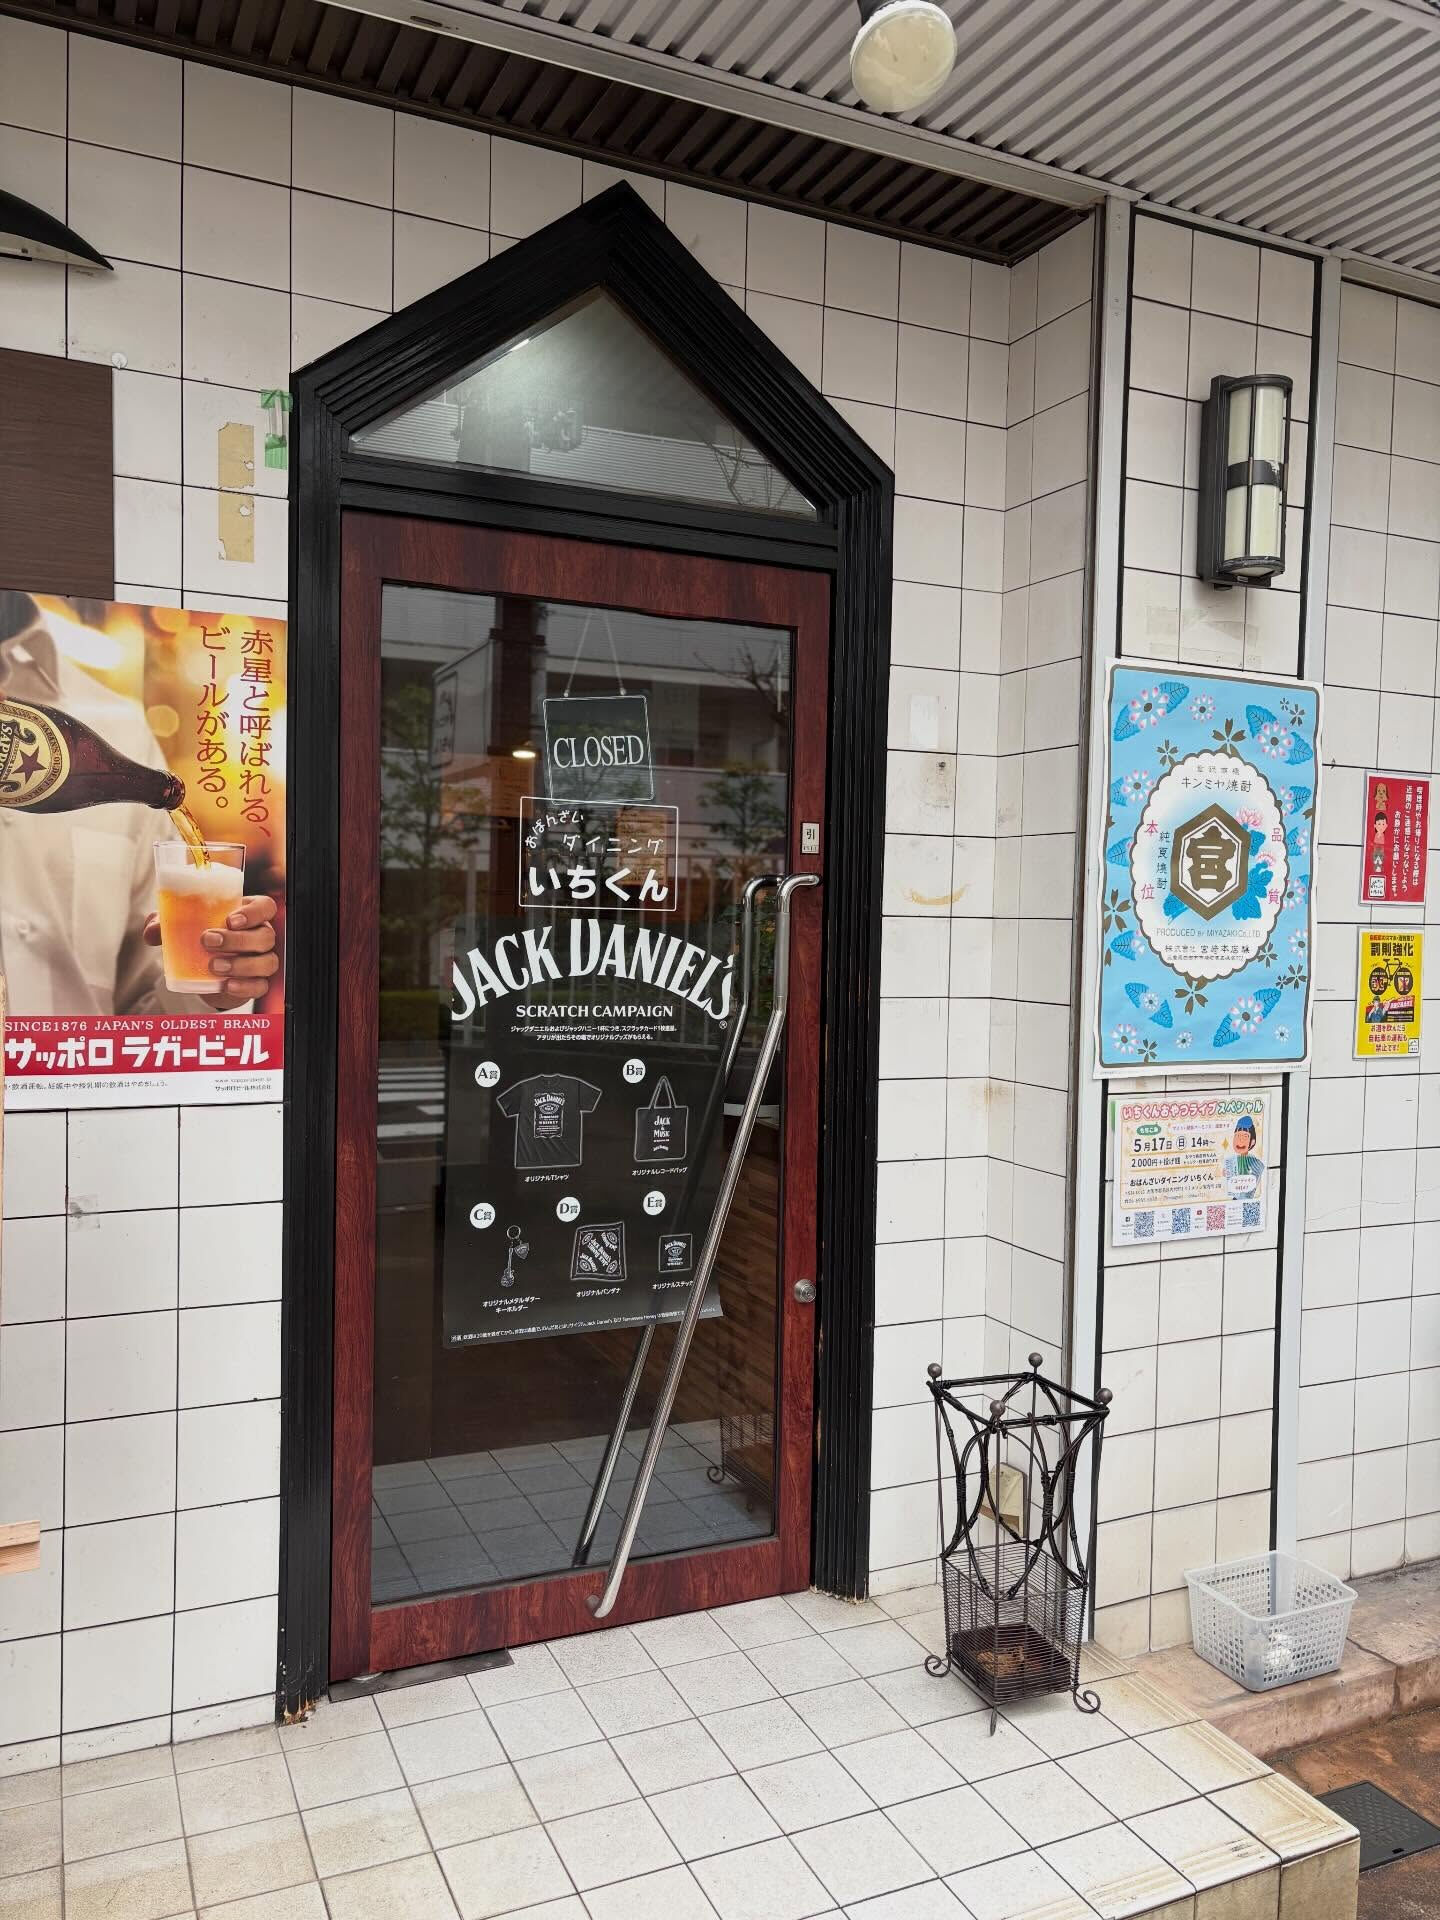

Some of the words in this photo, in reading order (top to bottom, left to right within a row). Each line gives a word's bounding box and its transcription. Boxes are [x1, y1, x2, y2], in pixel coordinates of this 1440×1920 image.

[196, 625, 231, 809] ビールがある。
[239, 629, 274, 838] 赤星と呼ばれる、
[553, 735, 644, 768] CLOSED
[1181, 776, 1252, 793] キンミヤ焼酎
[525, 810, 584, 849] おばんざい
[563, 834, 664, 855] ダイニング
[1141, 820, 1158, 900] 本位
[1268, 827, 1283, 905] 品質
[528, 865, 668, 902] いちくん
[1156, 928, 1196, 937] PRODUCED
[1370, 942, 1414, 957] 罰則強化
[452, 926, 564, 1021] JACK
[568, 919, 736, 1020] DANIEL'S
[516, 1005, 590, 1018] SCRATCH
[592, 1005, 673, 1018] CAMPAIGN
[4, 1021, 88, 1032] SINCE1876
[94, 1020, 154, 1031] JAPAN'S
[160, 1019, 217, 1030] OLDEST
[223, 1019, 271, 1029] BRAND
[4, 1036, 114, 1069] サッポロ
[121, 1034, 270, 1068] ラガービール
[1123, 1099, 1264, 1120] いちくんおやつライブスペシャル
[654, 1115, 670, 1126] JACK
[1133, 1137, 1173, 1153] 5月17日
[525, 1174, 569, 1183] オリジナルTシャツ
[1129, 1176, 1189, 1188] おばんざいダイニング
[1190, 1172, 1214, 1182] いちくん
[495, 1304, 529, 1313] キーホルダー
